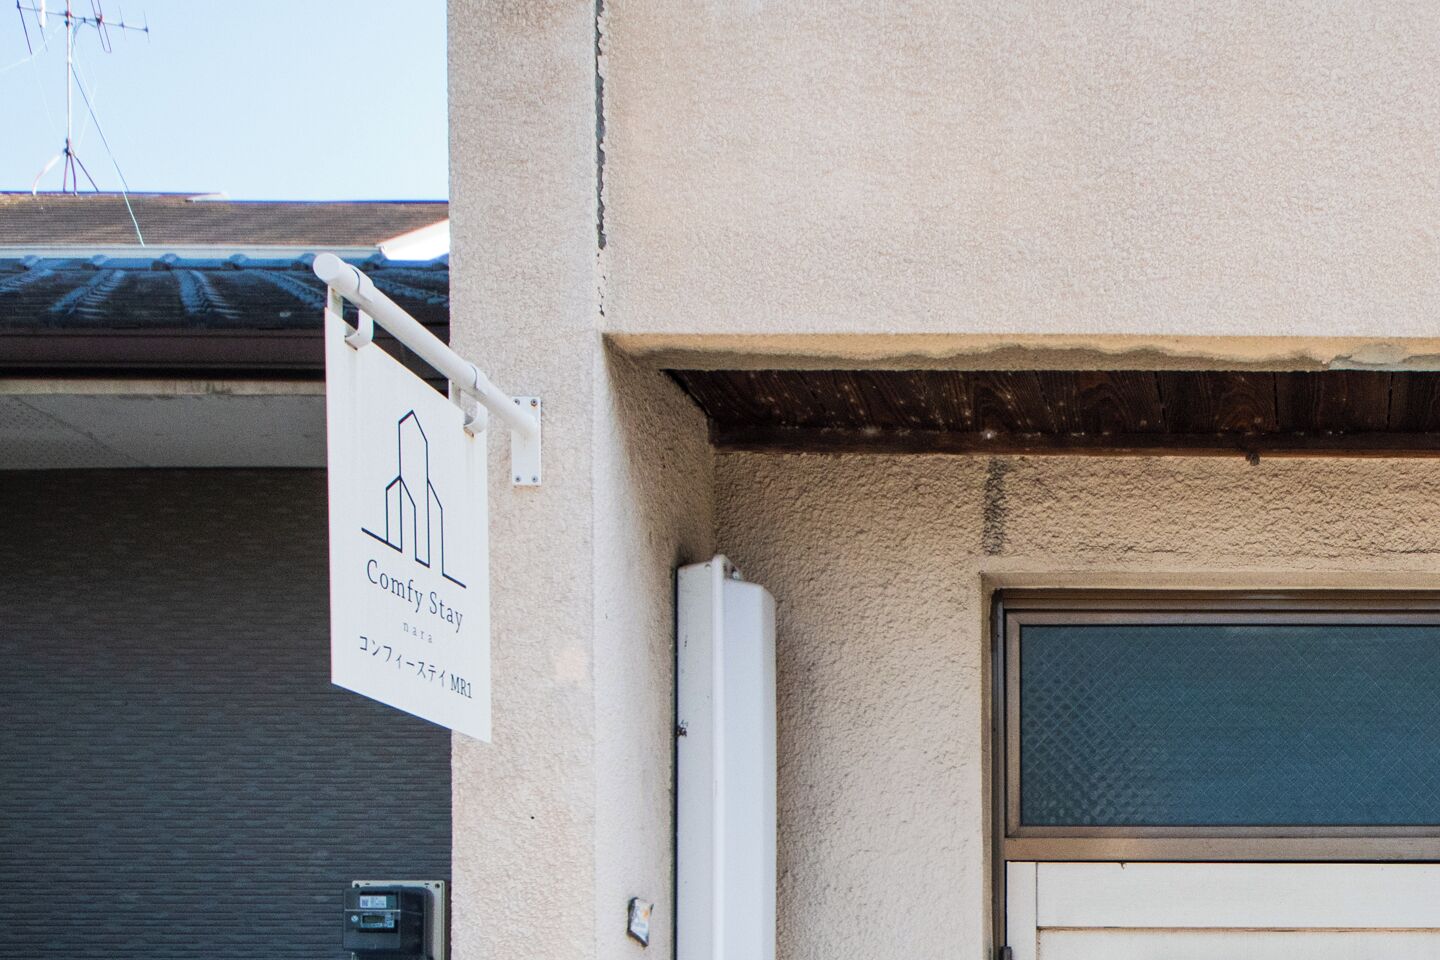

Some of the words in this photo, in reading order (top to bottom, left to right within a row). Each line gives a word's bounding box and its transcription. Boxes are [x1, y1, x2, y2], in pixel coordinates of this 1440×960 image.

[366, 558, 424, 614] Comfy
[429, 591, 463, 634] Stay
[403, 622, 433, 644] nara
[359, 635, 446, 688] コンフィーステイ
[450, 673, 473, 699] MR1
